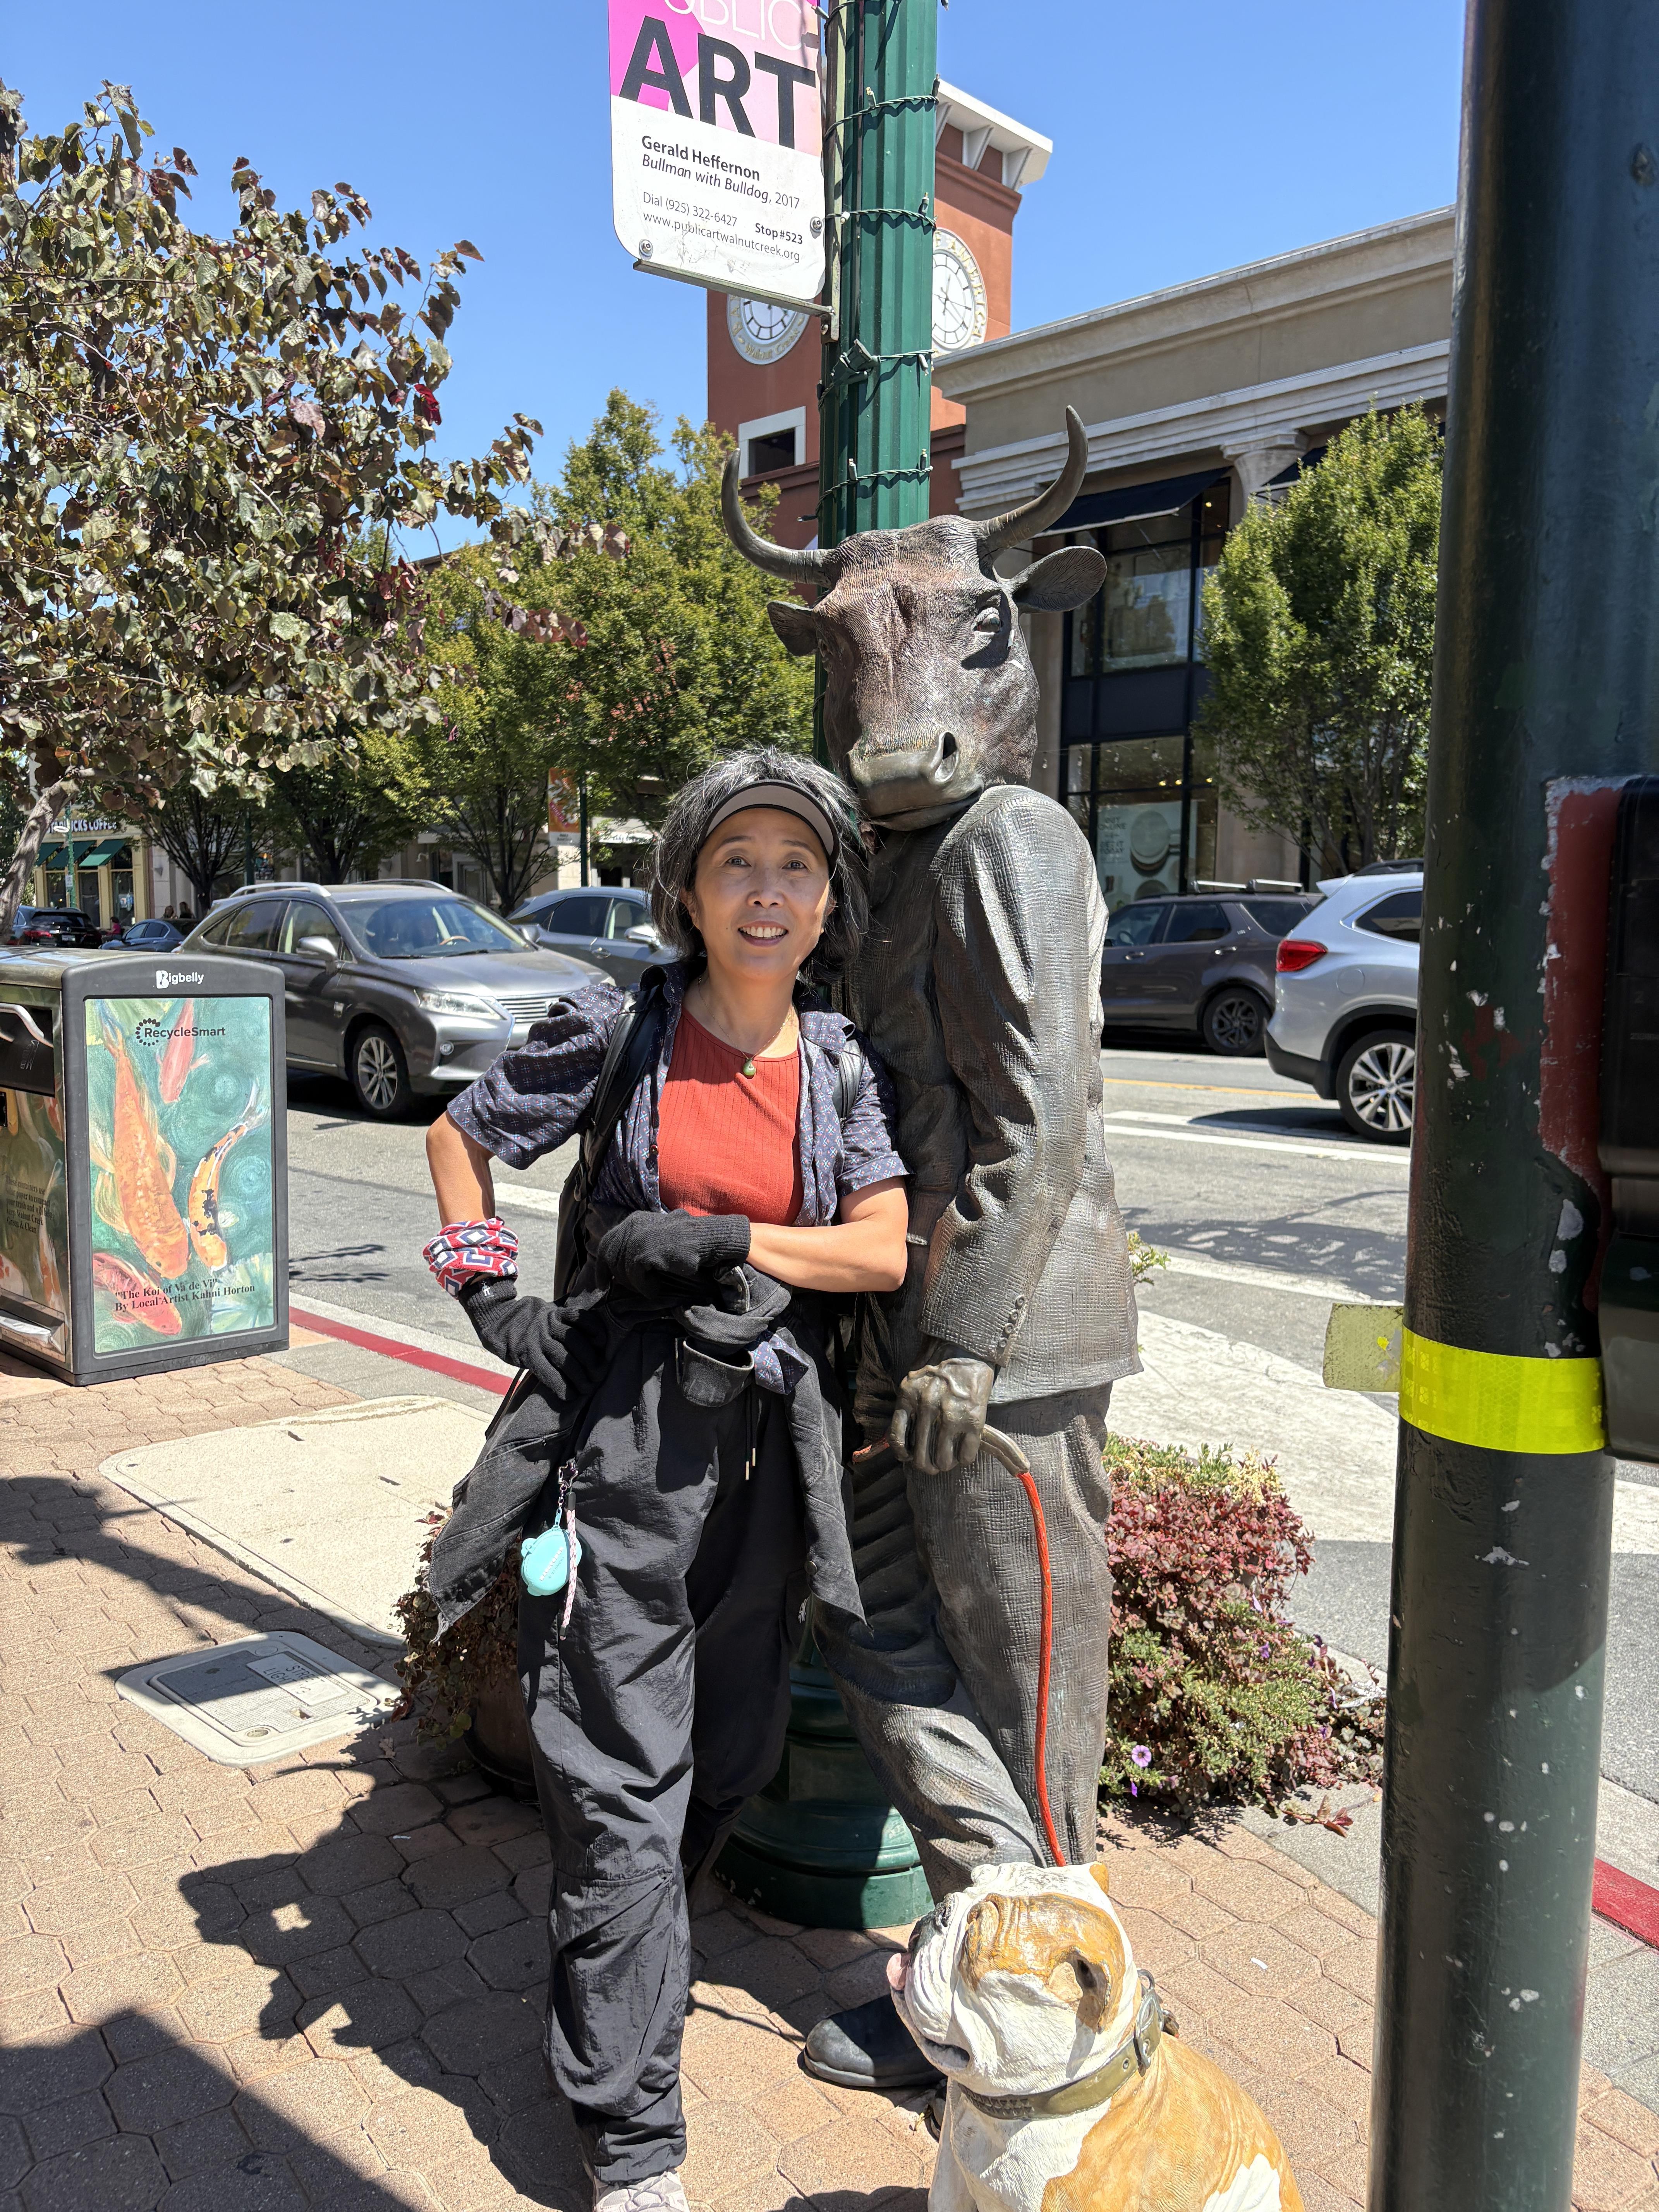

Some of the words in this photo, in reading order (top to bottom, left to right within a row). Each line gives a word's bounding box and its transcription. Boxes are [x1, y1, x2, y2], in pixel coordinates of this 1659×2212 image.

[619, 15, 816, 149] ART
[642, 135, 688, 160] Gerald
[692, 149, 760, 181] Heffernon
[642, 154, 691, 179] Bullman
[696, 172, 721, 187] with
[725, 177, 771, 204] Bulldog,
[775, 192, 800, 209] 2017
[643, 192, 662, 207] Dial
[666, 198, 689, 216] (925)
[692, 206, 737, 227] 322-6427
[643, 212, 800, 263] www.publicartwalnutcreek.org
[156, 970, 204, 989] Bigbelly
[144, 1027, 226, 1040] RecycleSmart
[116, 1302, 128, 1312] By
[132, 1297, 159, 1309] Local
[161, 1293, 189, 1305] Artist
[192, 1288, 220, 1300] Kahni
[223, 1284, 255, 1296] Horton
[143, 1286, 160, 1297] Koi
[163, 1284, 172, 1294] of
[175, 1283, 186, 1292] Va
[189, 1281, 200, 1291] de
